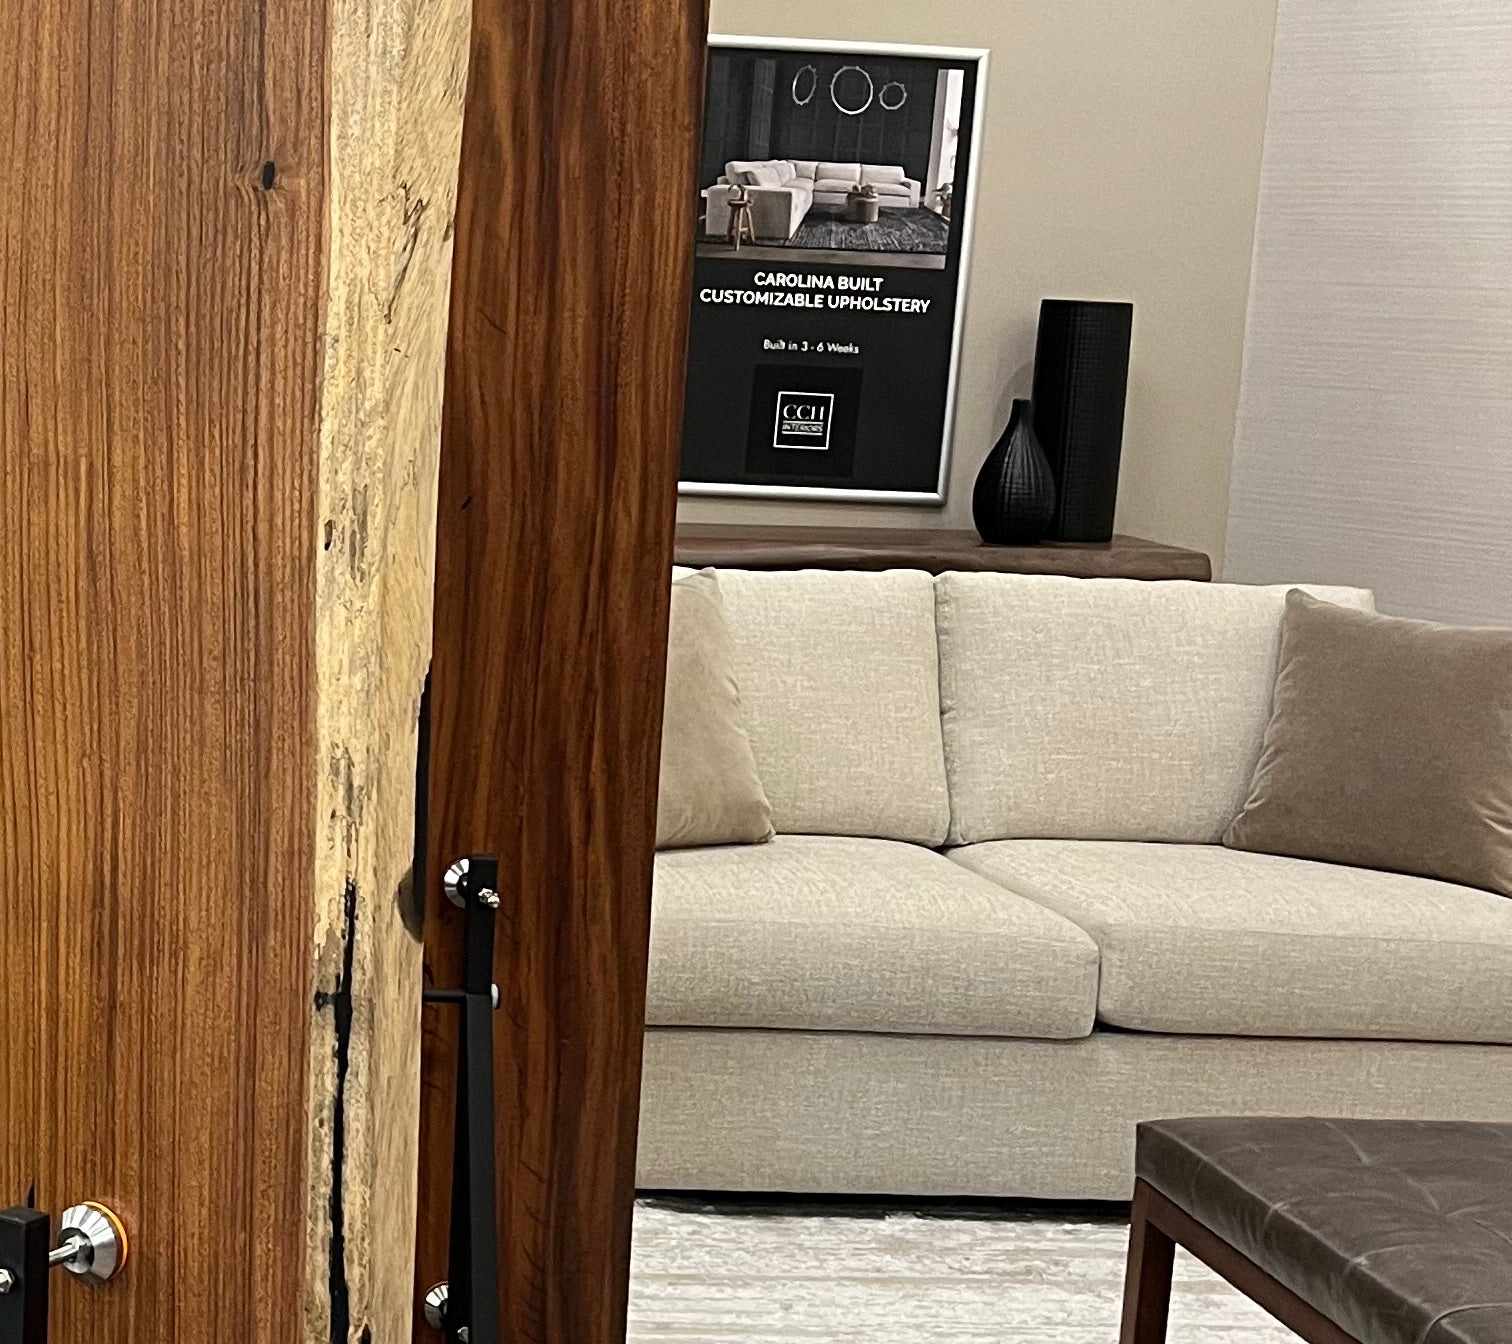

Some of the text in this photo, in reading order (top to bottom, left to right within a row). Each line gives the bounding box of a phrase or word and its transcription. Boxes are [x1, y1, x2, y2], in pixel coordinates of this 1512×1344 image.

[754, 272, 884, 291] CAROLINA BUILT
[700, 289, 930, 313] CUSTOMIZABLE UPHOLSTERY
[763, 339, 786, 350] Built
[788, 341, 798, 351] in
[801, 341, 809, 352] 3
[817, 342, 824, 352] 6
[827, 342, 859, 354] Weeks
[783, 404, 825, 420] CCH
[781, 423, 823, 433] INTERIORS
